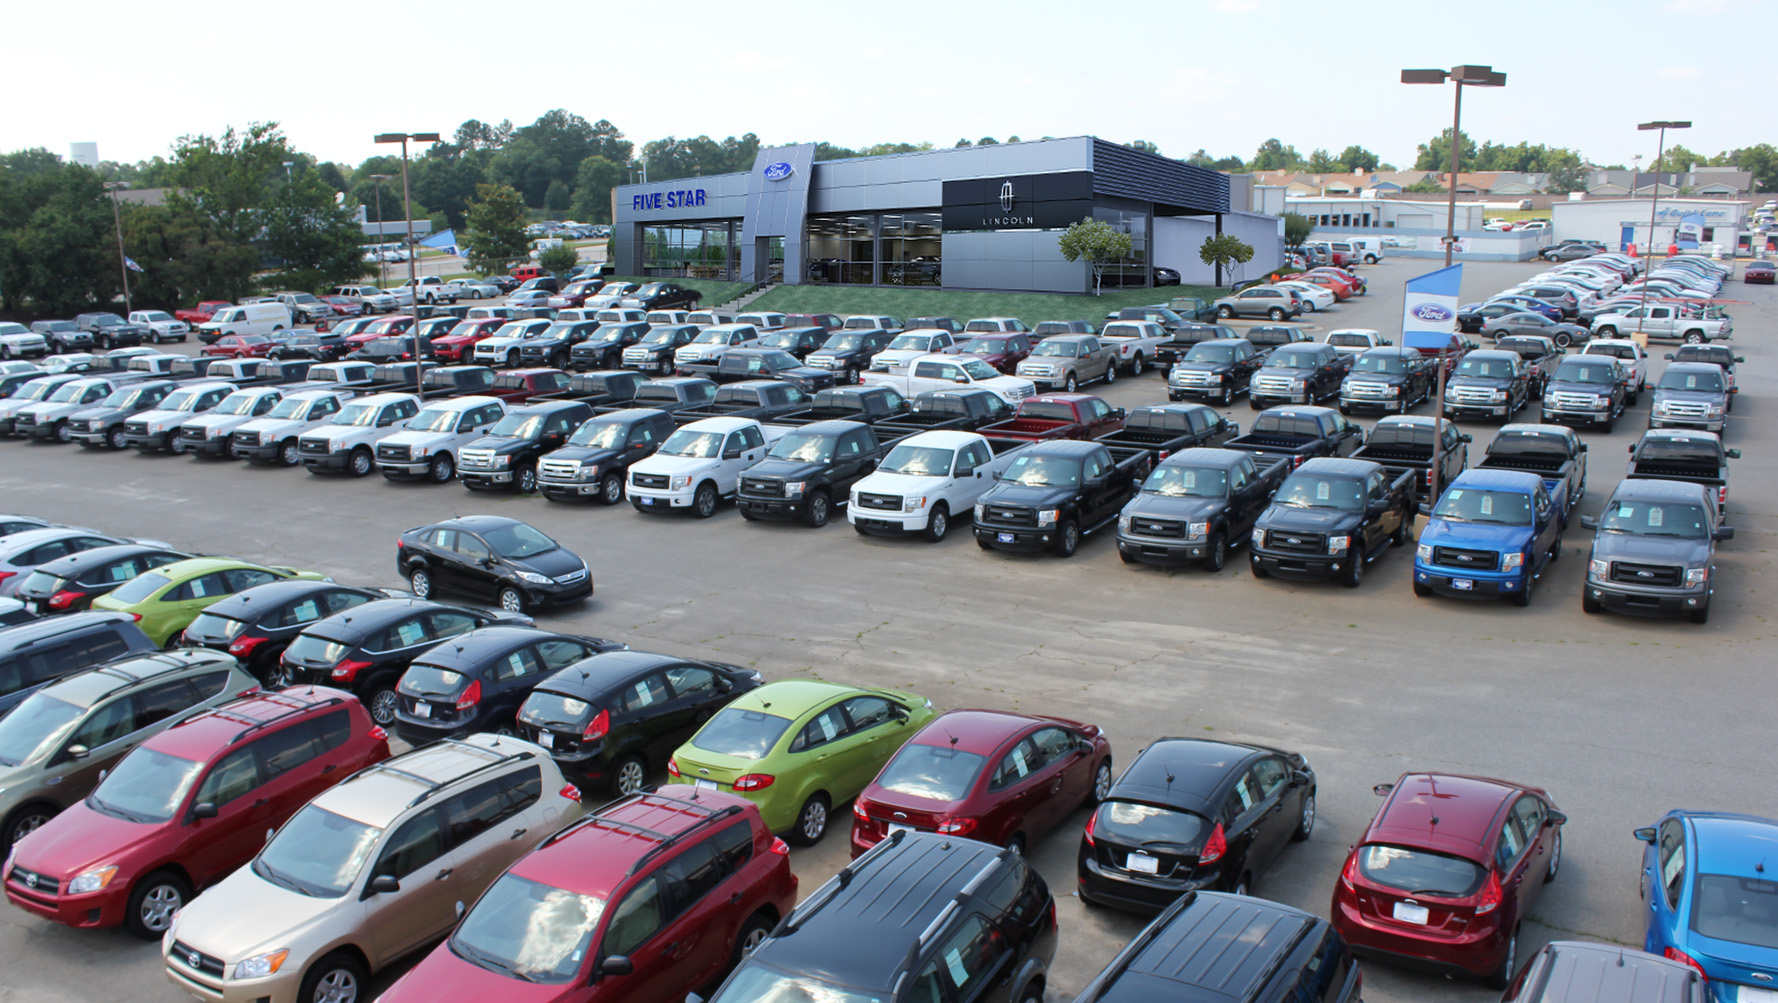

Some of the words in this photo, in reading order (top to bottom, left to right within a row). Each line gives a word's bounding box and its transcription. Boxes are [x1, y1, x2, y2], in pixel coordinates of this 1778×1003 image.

[768, 164, 788, 177] Ford
[633, 193, 662, 210] FIVE
[667, 189, 706, 208] STAR
[1700, 209, 1726, 217] Lane
[982, 216, 1033, 225] LINCOLN
[1419, 305, 1447, 320] Ford
